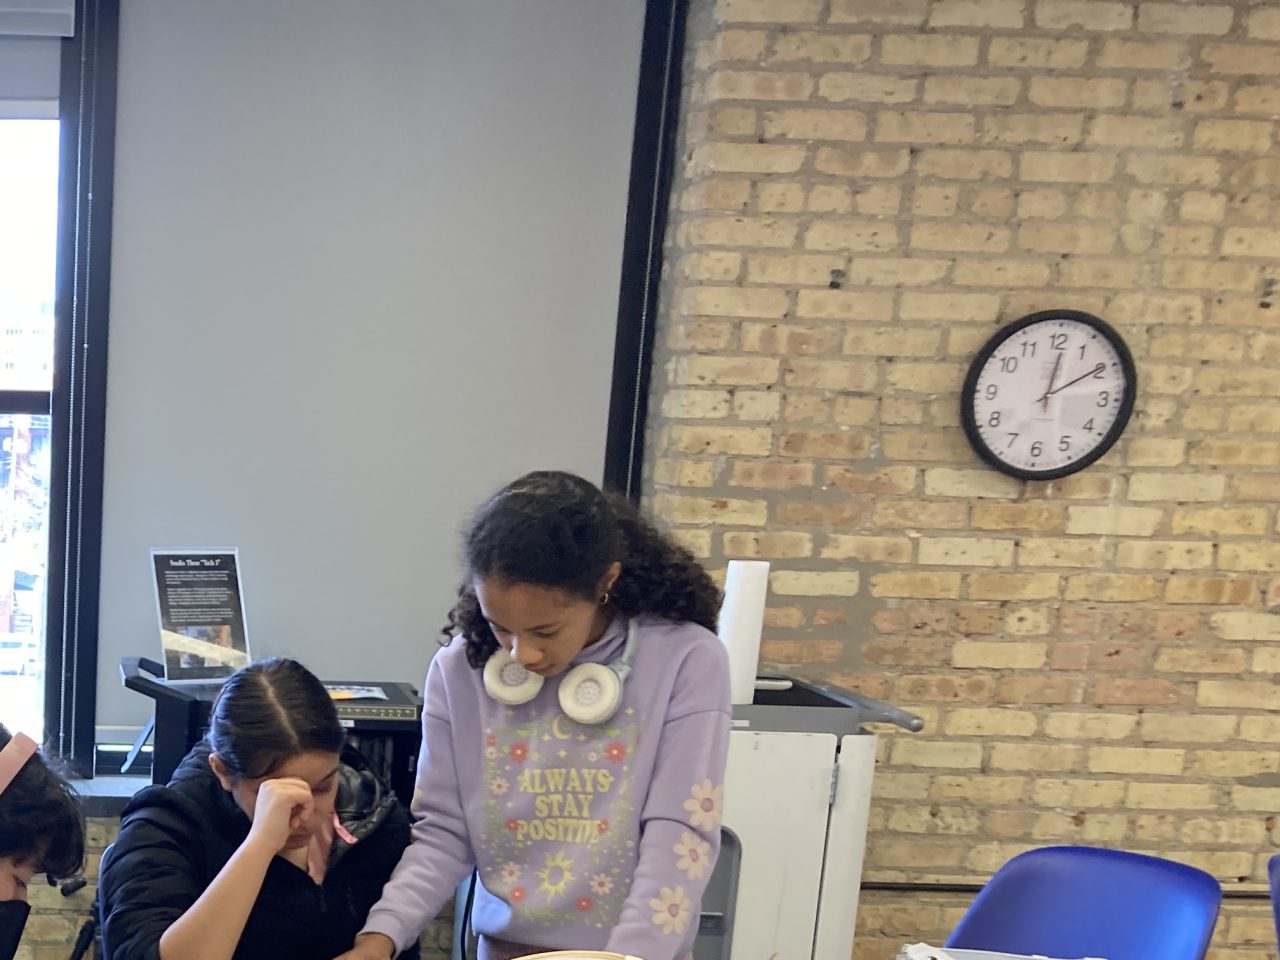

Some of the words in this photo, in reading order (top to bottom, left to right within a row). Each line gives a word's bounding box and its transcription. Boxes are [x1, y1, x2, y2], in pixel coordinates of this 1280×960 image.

[1020, 341, 1037, 358] 11
[1048, 333, 1068, 351] 12
[1078, 344, 1087, 361] 1
[999, 356, 1019, 374] 10
[1092, 362, 1107, 380] 2
[985, 383, 999, 401] 9
[1096, 390, 1109, 408] 3
[988, 411, 1001, 428] 8
[1082, 418, 1095, 433] 4
[1006, 432, 1019, 449] 7
[1030, 440, 1043, 458] 6
[1057, 435, 1072, 452] 5
[517, 767, 615, 794] ALWAYS
[534, 793, 594, 818] STAY
